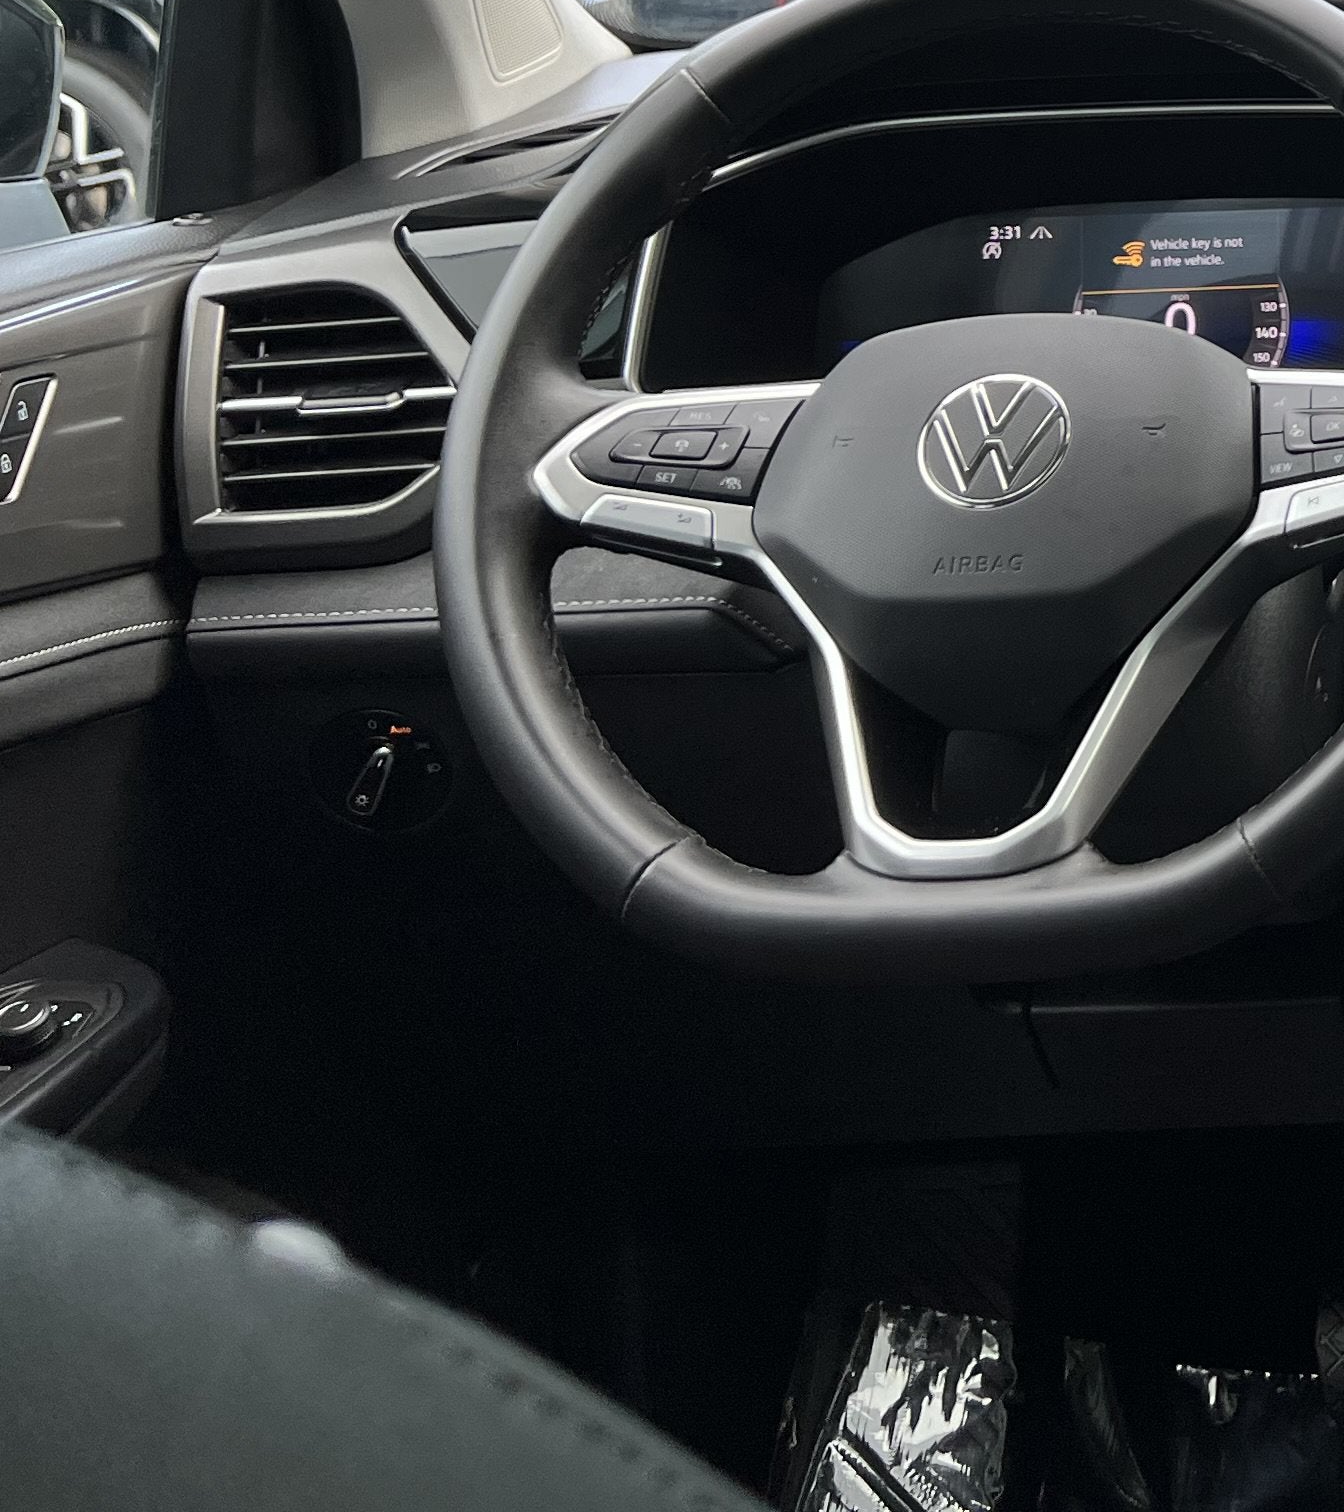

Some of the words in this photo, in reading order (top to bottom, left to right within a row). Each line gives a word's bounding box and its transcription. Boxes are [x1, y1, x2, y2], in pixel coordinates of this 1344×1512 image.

[989, 225, 1021, 239] 3:31
[1150, 239, 1189, 251] Vehicle
[1191, 239, 1212, 252] key
[1214, 238, 1223, 248] is
[1224, 237, 1244, 248] not
[1150, 256, 1162, 267] in
[1165, 255, 1182, 267] the
[1184, 254, 1225, 266] vehicle.
[1260, 301, 1278, 312] 130
[1164, 302, 1197, 336] 0
[1255, 327, 1278, 338] 140
[1253, 352, 1271, 363] 150
[1325, 422, 1341, 431] OK
[917, 373, 1071, 511] VW
[1269, 462, 1293, 474] VIEW
[655, 472, 677, 483] SET
[932, 553, 1025, 576] AIRBAG
